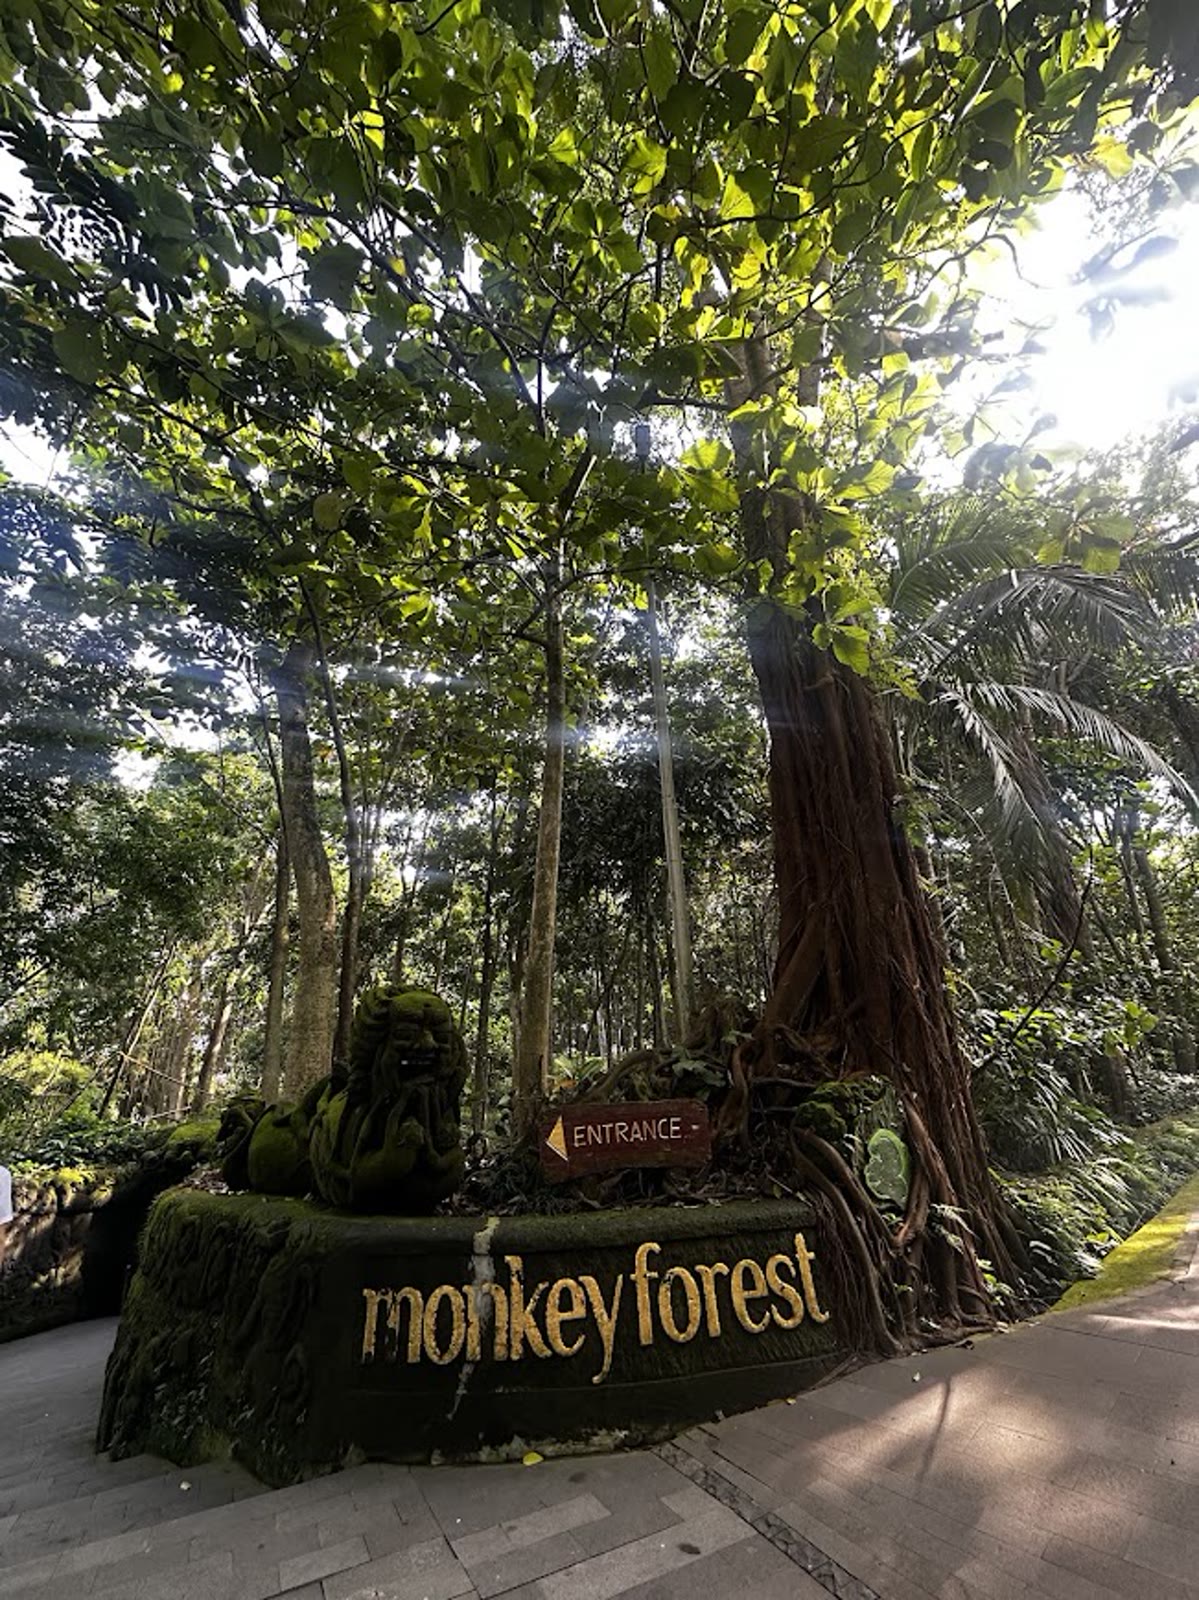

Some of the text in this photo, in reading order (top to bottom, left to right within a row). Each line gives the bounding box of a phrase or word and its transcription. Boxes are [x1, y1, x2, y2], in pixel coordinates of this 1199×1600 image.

[573, 1117, 682, 1148] ENTRANCE
[361, 1232, 831, 1384] monkey forest
